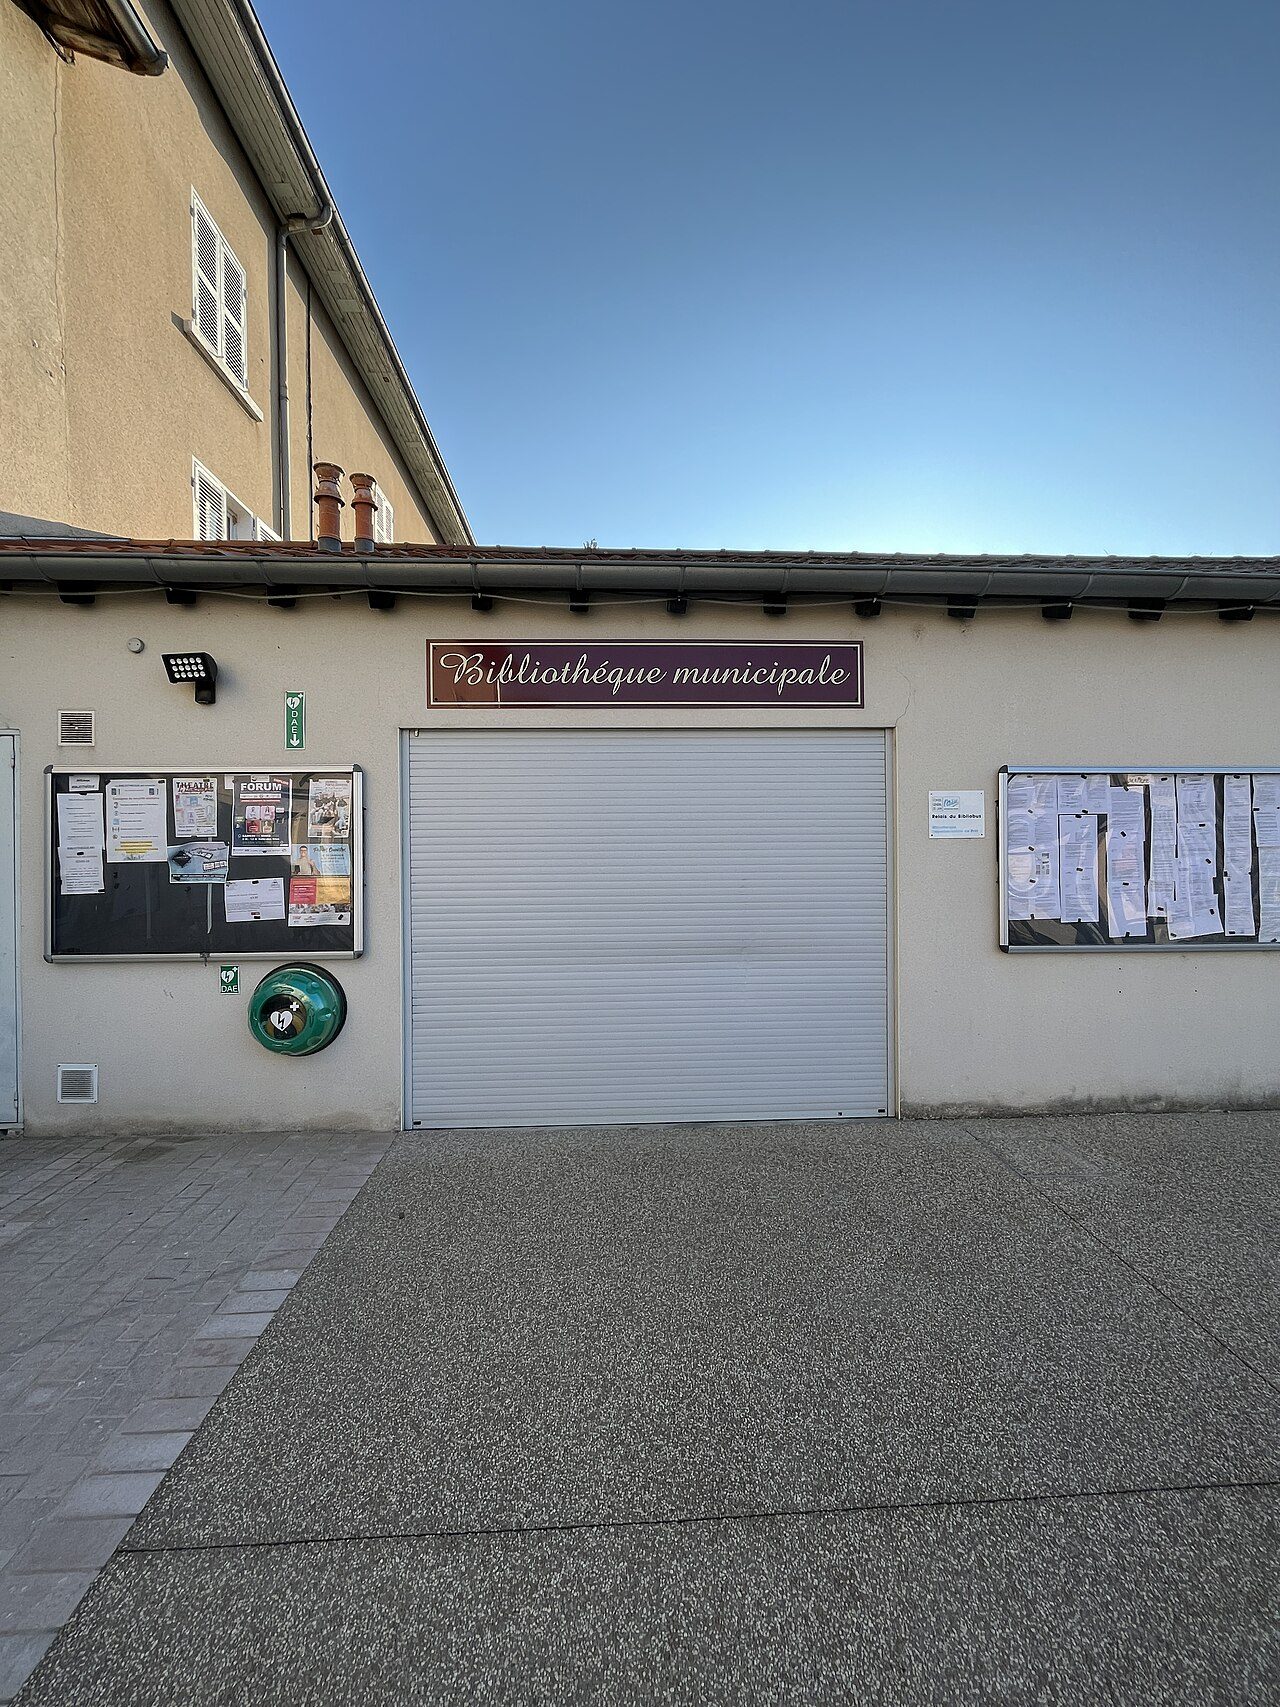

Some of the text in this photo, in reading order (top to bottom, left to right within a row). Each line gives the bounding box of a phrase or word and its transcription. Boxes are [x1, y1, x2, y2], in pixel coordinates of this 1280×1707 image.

[440, 653, 850, 695] Bibliothéque municipale
[240, 782, 282, 791] FORUM
[221, 985, 238, 993] DAE
